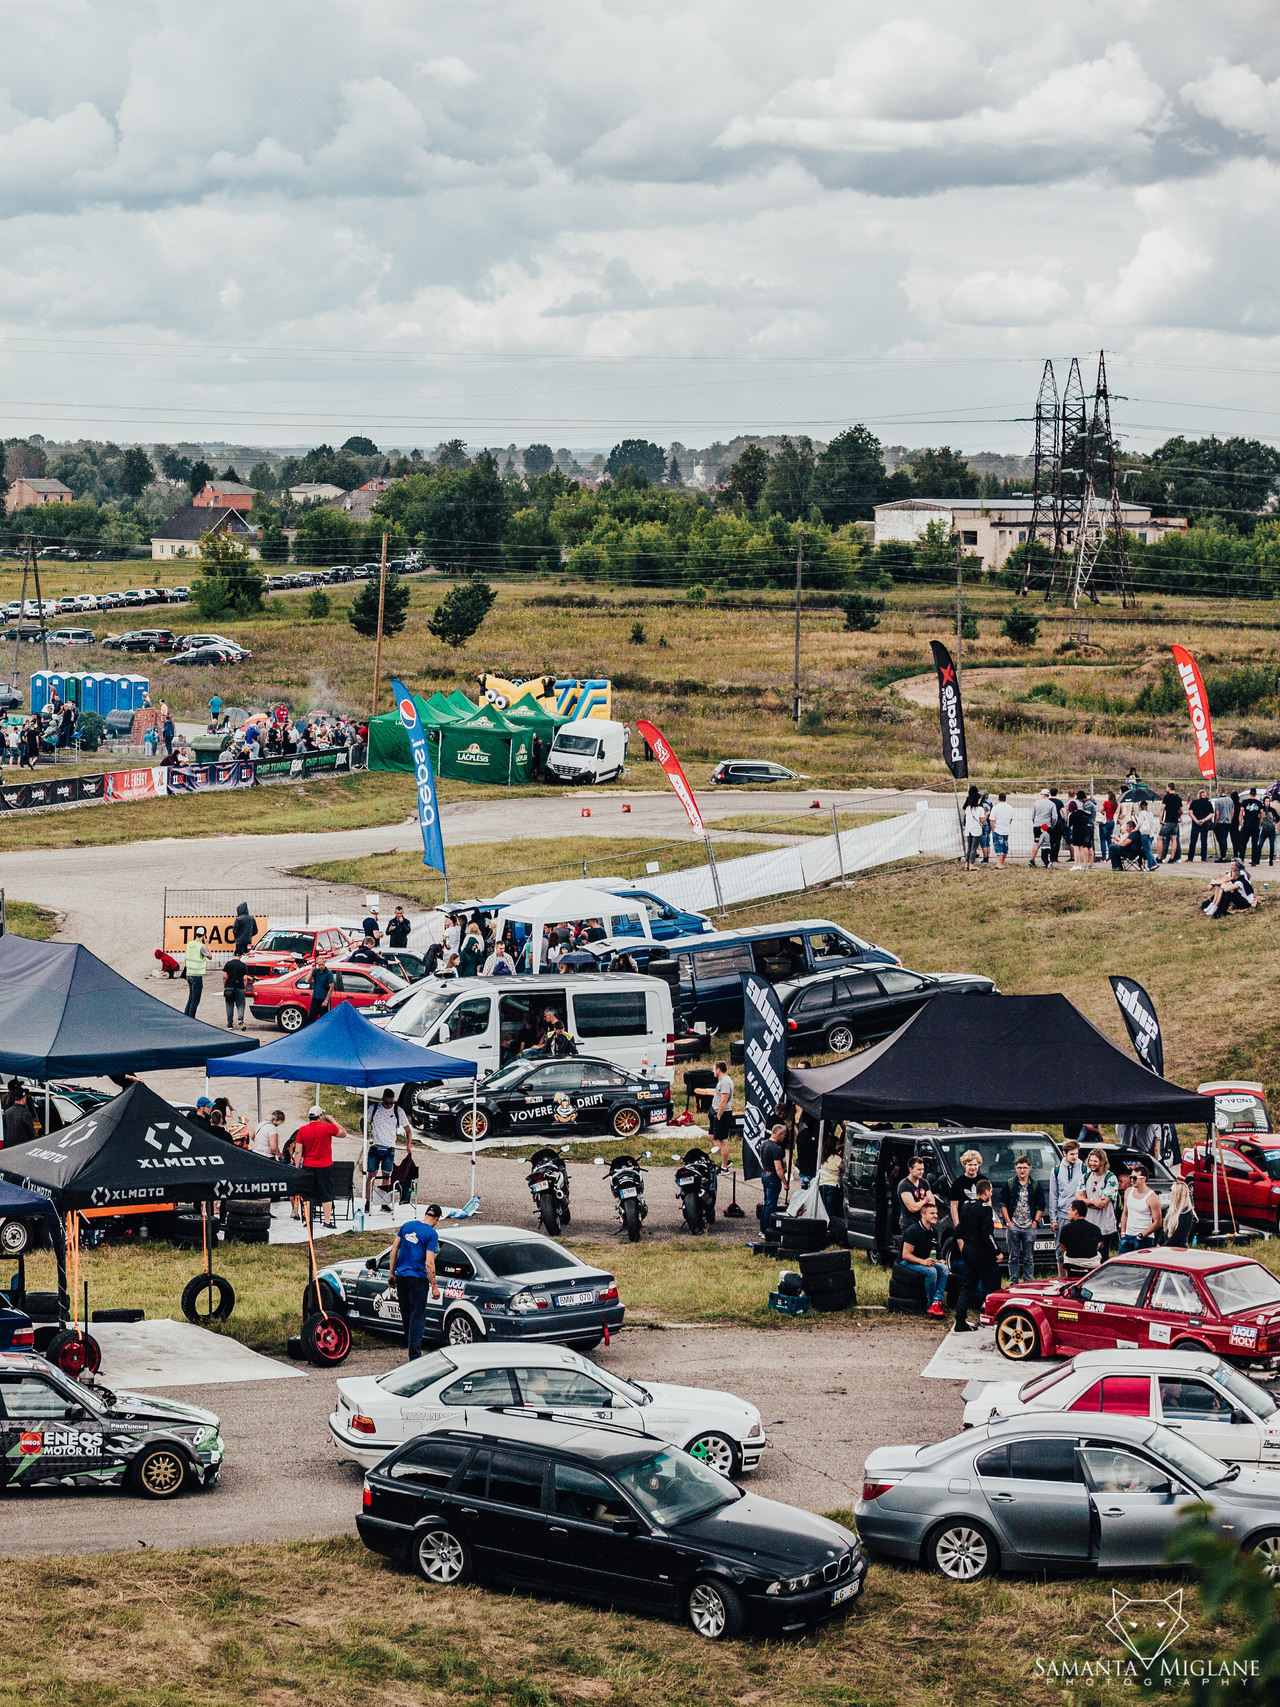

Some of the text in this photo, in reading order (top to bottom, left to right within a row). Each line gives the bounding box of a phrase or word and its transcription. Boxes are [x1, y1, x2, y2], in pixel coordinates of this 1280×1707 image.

[577, 1093, 604, 1109] DRIFT
[510, 1105, 553, 1123] VOVERE
[26, 1147, 68, 1164] XLMOTO
[137, 1155, 225, 1169] XLMOTO
[112, 1187, 164, 1200] XLMOTO
[235, 1182, 287, 1193] XLMOTO
[447, 1278, 467, 1290] LIQUI
[445, 1287, 465, 1299] MOLY
[560, 1292, 592, 1305] BMW 070
[1232, 1325, 1258, 1337] LIQUI
[1230, 1335, 1256, 1347] MOLY
[44, 1432, 103, 1448] ENEOS
[43, 1446, 103, 1456] MOTOR OIL
